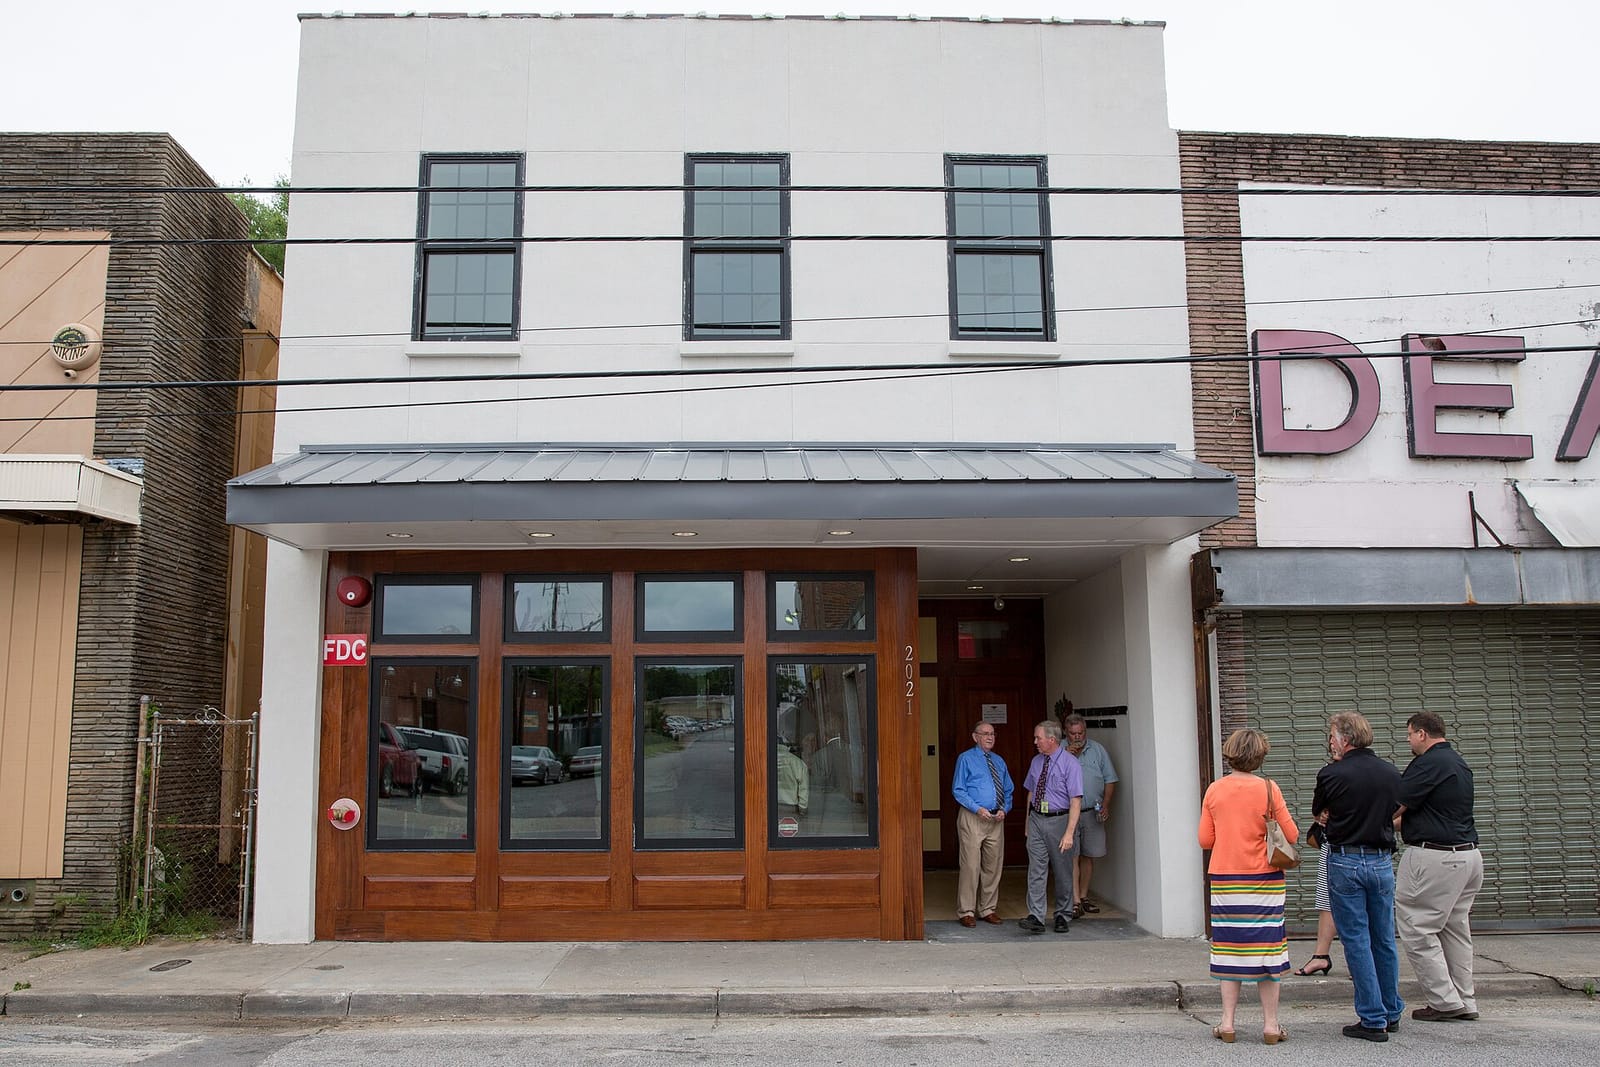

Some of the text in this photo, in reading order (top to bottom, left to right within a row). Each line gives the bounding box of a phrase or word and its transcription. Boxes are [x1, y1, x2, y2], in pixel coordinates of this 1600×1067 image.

[53, 344, 88, 361] VIKING
[323, 639, 367, 661] FDC
[905, 645, 914, 715] 2021
